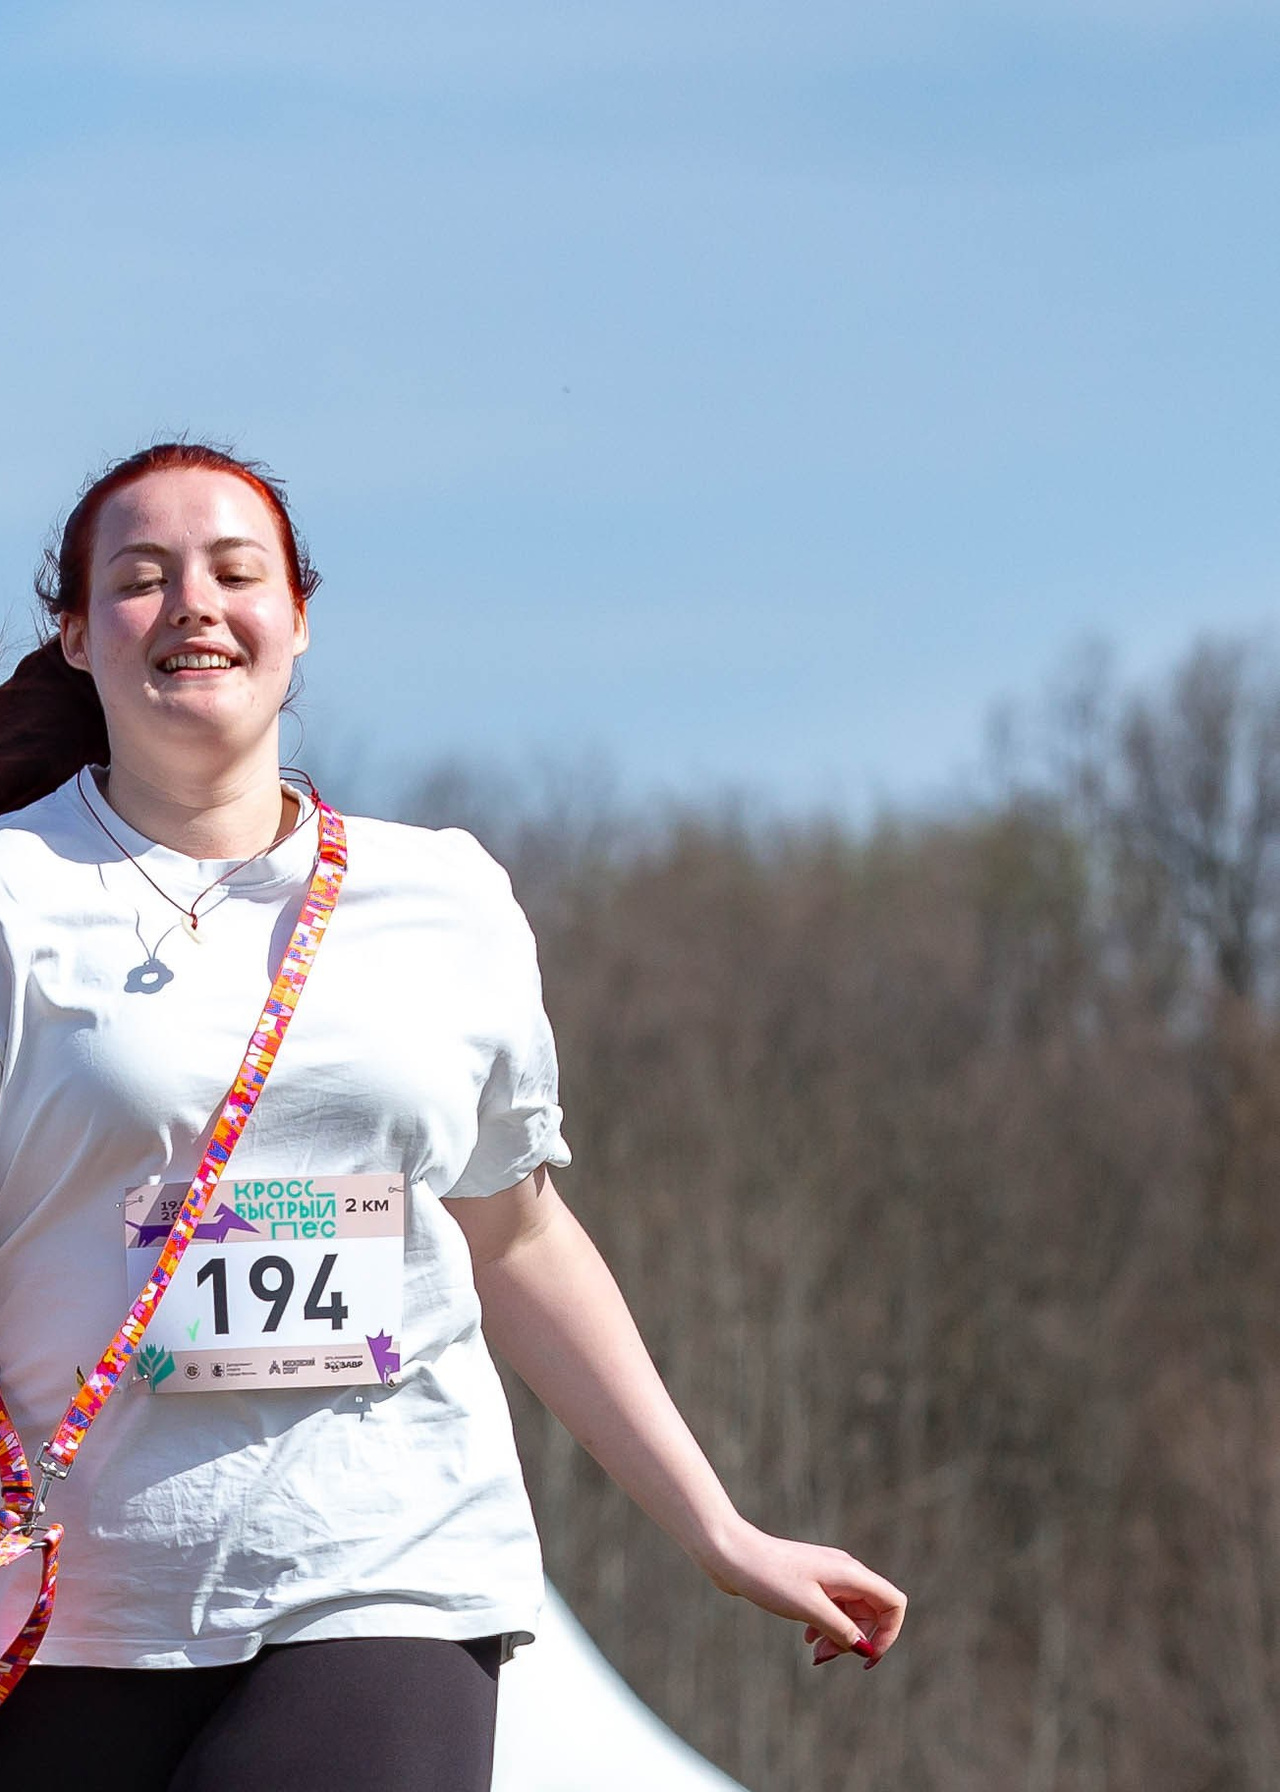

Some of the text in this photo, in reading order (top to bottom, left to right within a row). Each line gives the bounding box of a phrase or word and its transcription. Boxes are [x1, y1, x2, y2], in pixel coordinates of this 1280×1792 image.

[234, 1180, 335, 1200] КРОСС
[235, 1199, 337, 1221] БЫСТРЫЙ
[345, 1198, 390, 1213] 2 КМ
[197, 1253, 348, 1335] 194
